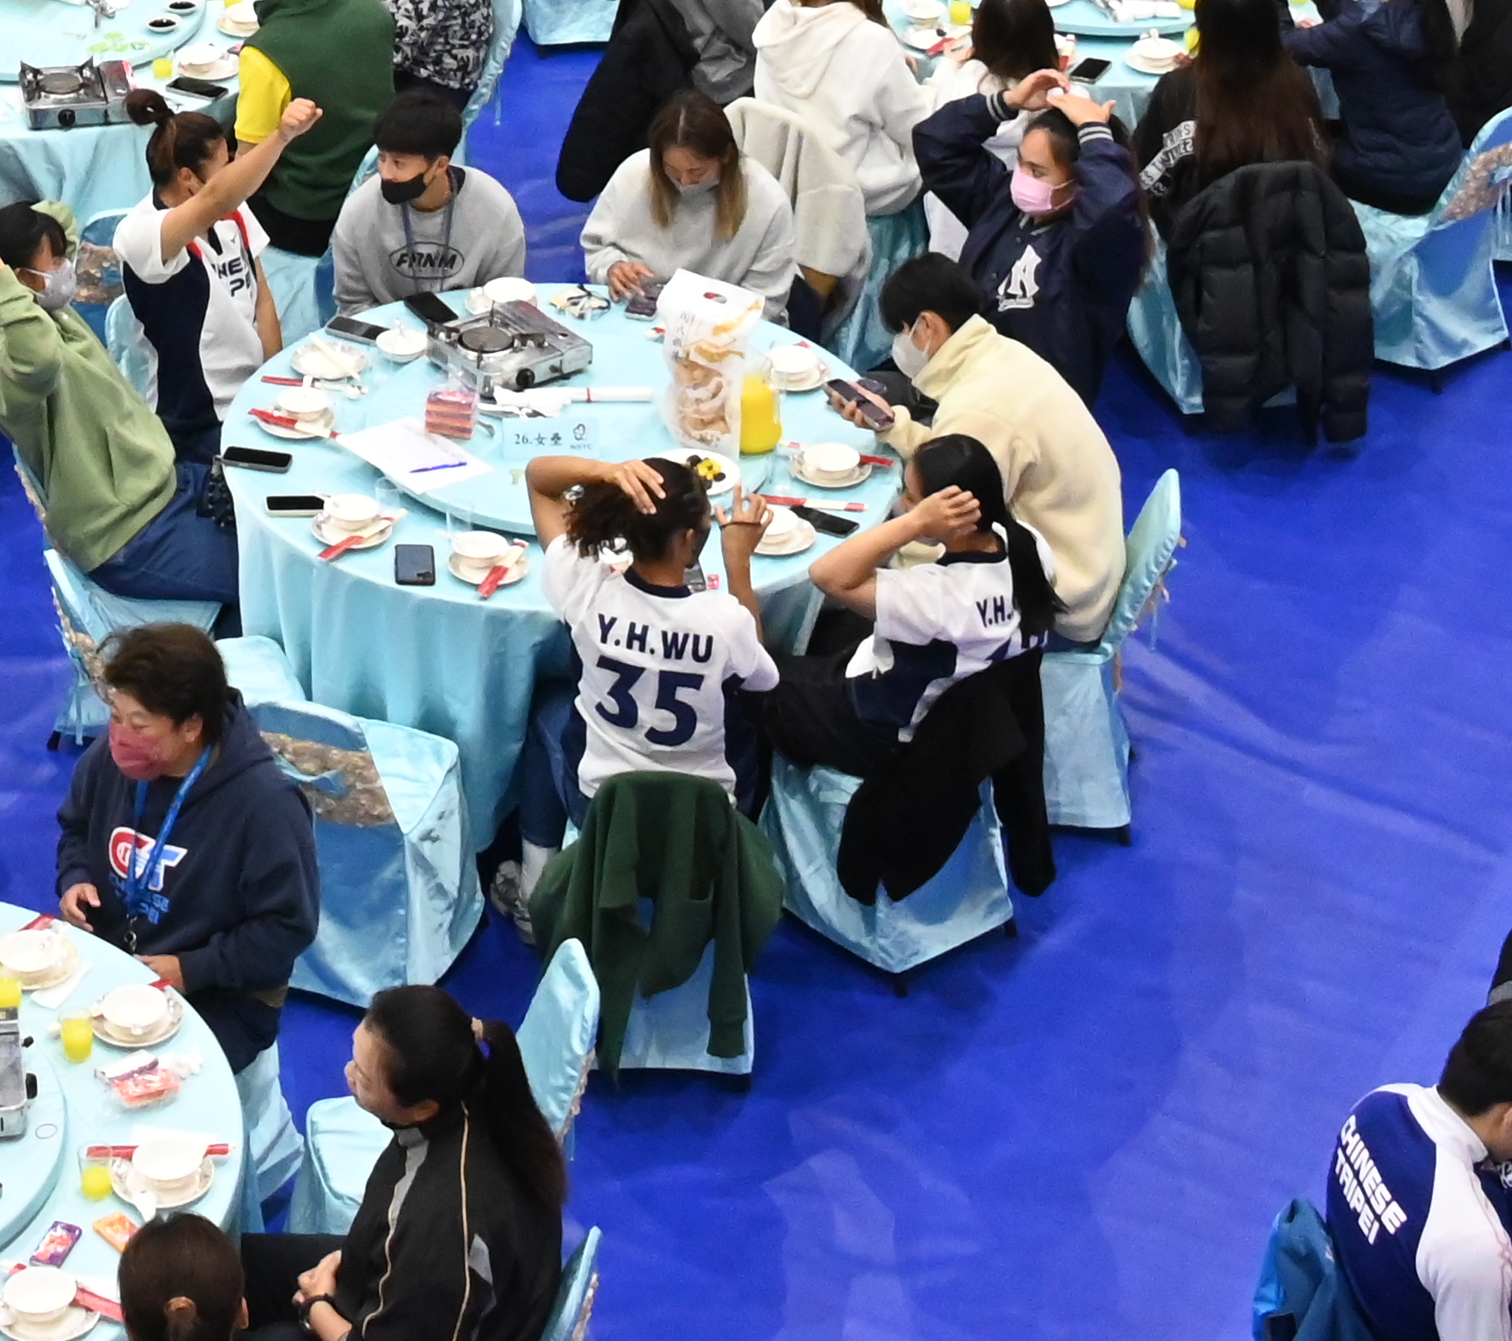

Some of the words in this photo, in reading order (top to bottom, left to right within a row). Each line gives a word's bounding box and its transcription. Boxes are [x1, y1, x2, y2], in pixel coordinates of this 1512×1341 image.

[514, 427, 562, 447] 26.女壘
[597, 613, 714, 666] Y.H.WU
[593, 657, 708, 746] 35
[1334, 1146, 1380, 1247] TAIPEI
[1343, 1113, 1408, 1236] CHINESE
